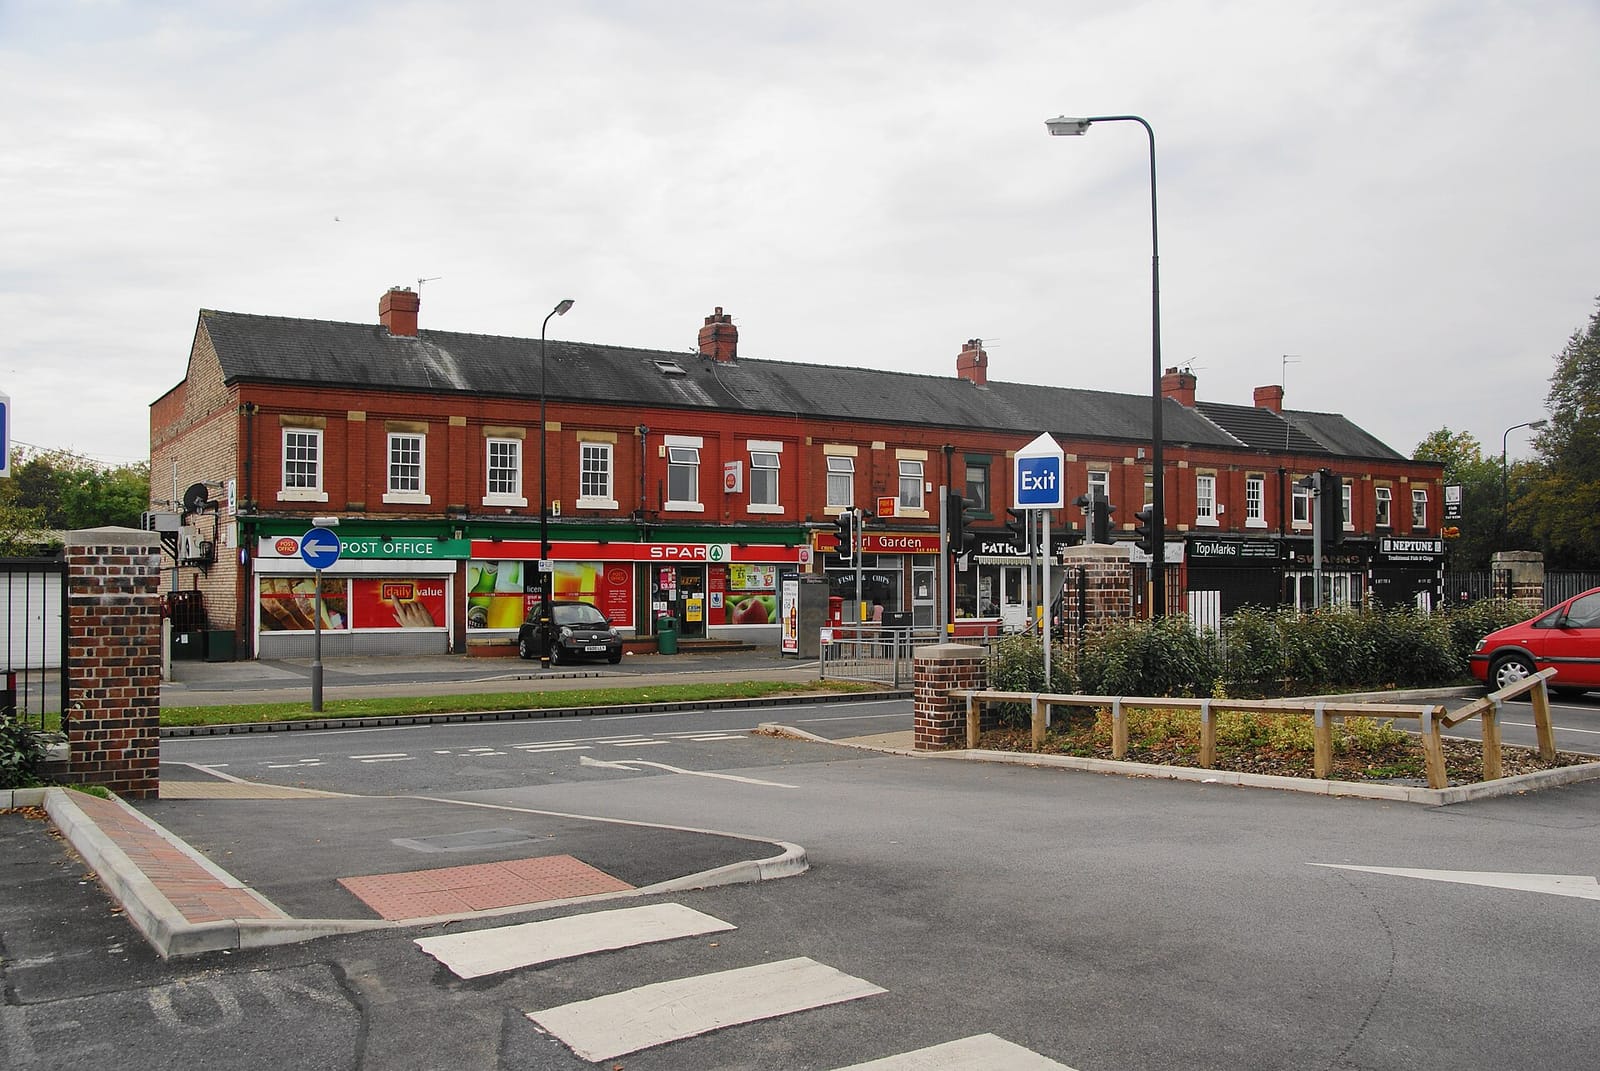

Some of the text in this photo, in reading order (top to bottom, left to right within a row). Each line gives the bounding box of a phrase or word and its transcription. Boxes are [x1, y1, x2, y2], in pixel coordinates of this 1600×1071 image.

[1021, 469, 1056, 490] Exit
[341, 542, 433, 554] POST OFFICE
[879, 536, 922, 548] Garden
[1392, 541, 1433, 551] NEPTUNE
[650, 547, 706, 558] SPAR
[838, 574, 854, 584] FISH
[872, 575, 890, 584] CHIPS
[386, 584, 443, 597] daily value
